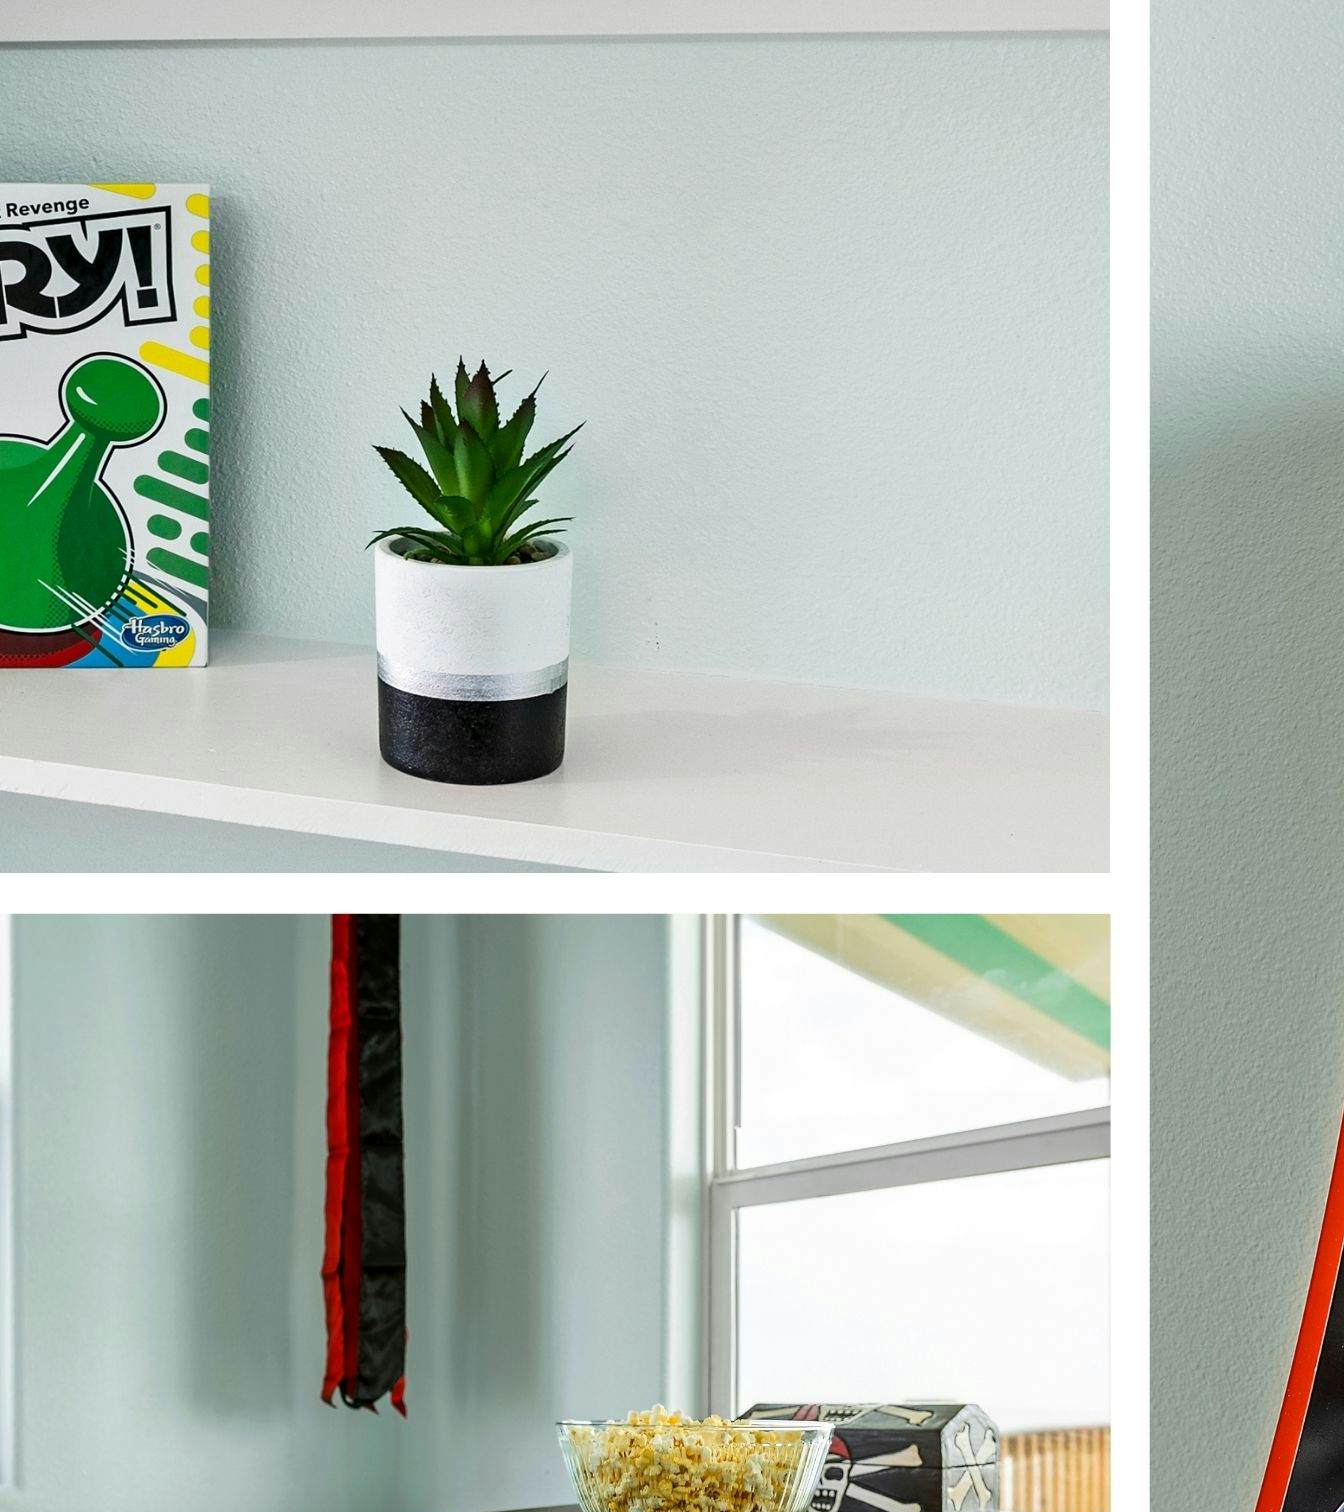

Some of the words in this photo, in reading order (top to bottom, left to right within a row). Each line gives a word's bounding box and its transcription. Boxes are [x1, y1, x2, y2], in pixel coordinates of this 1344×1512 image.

[6, 198, 91, 219] Revenge
[124, 619, 185, 637] Hasbro
[135, 633, 176, 647] Gaming
